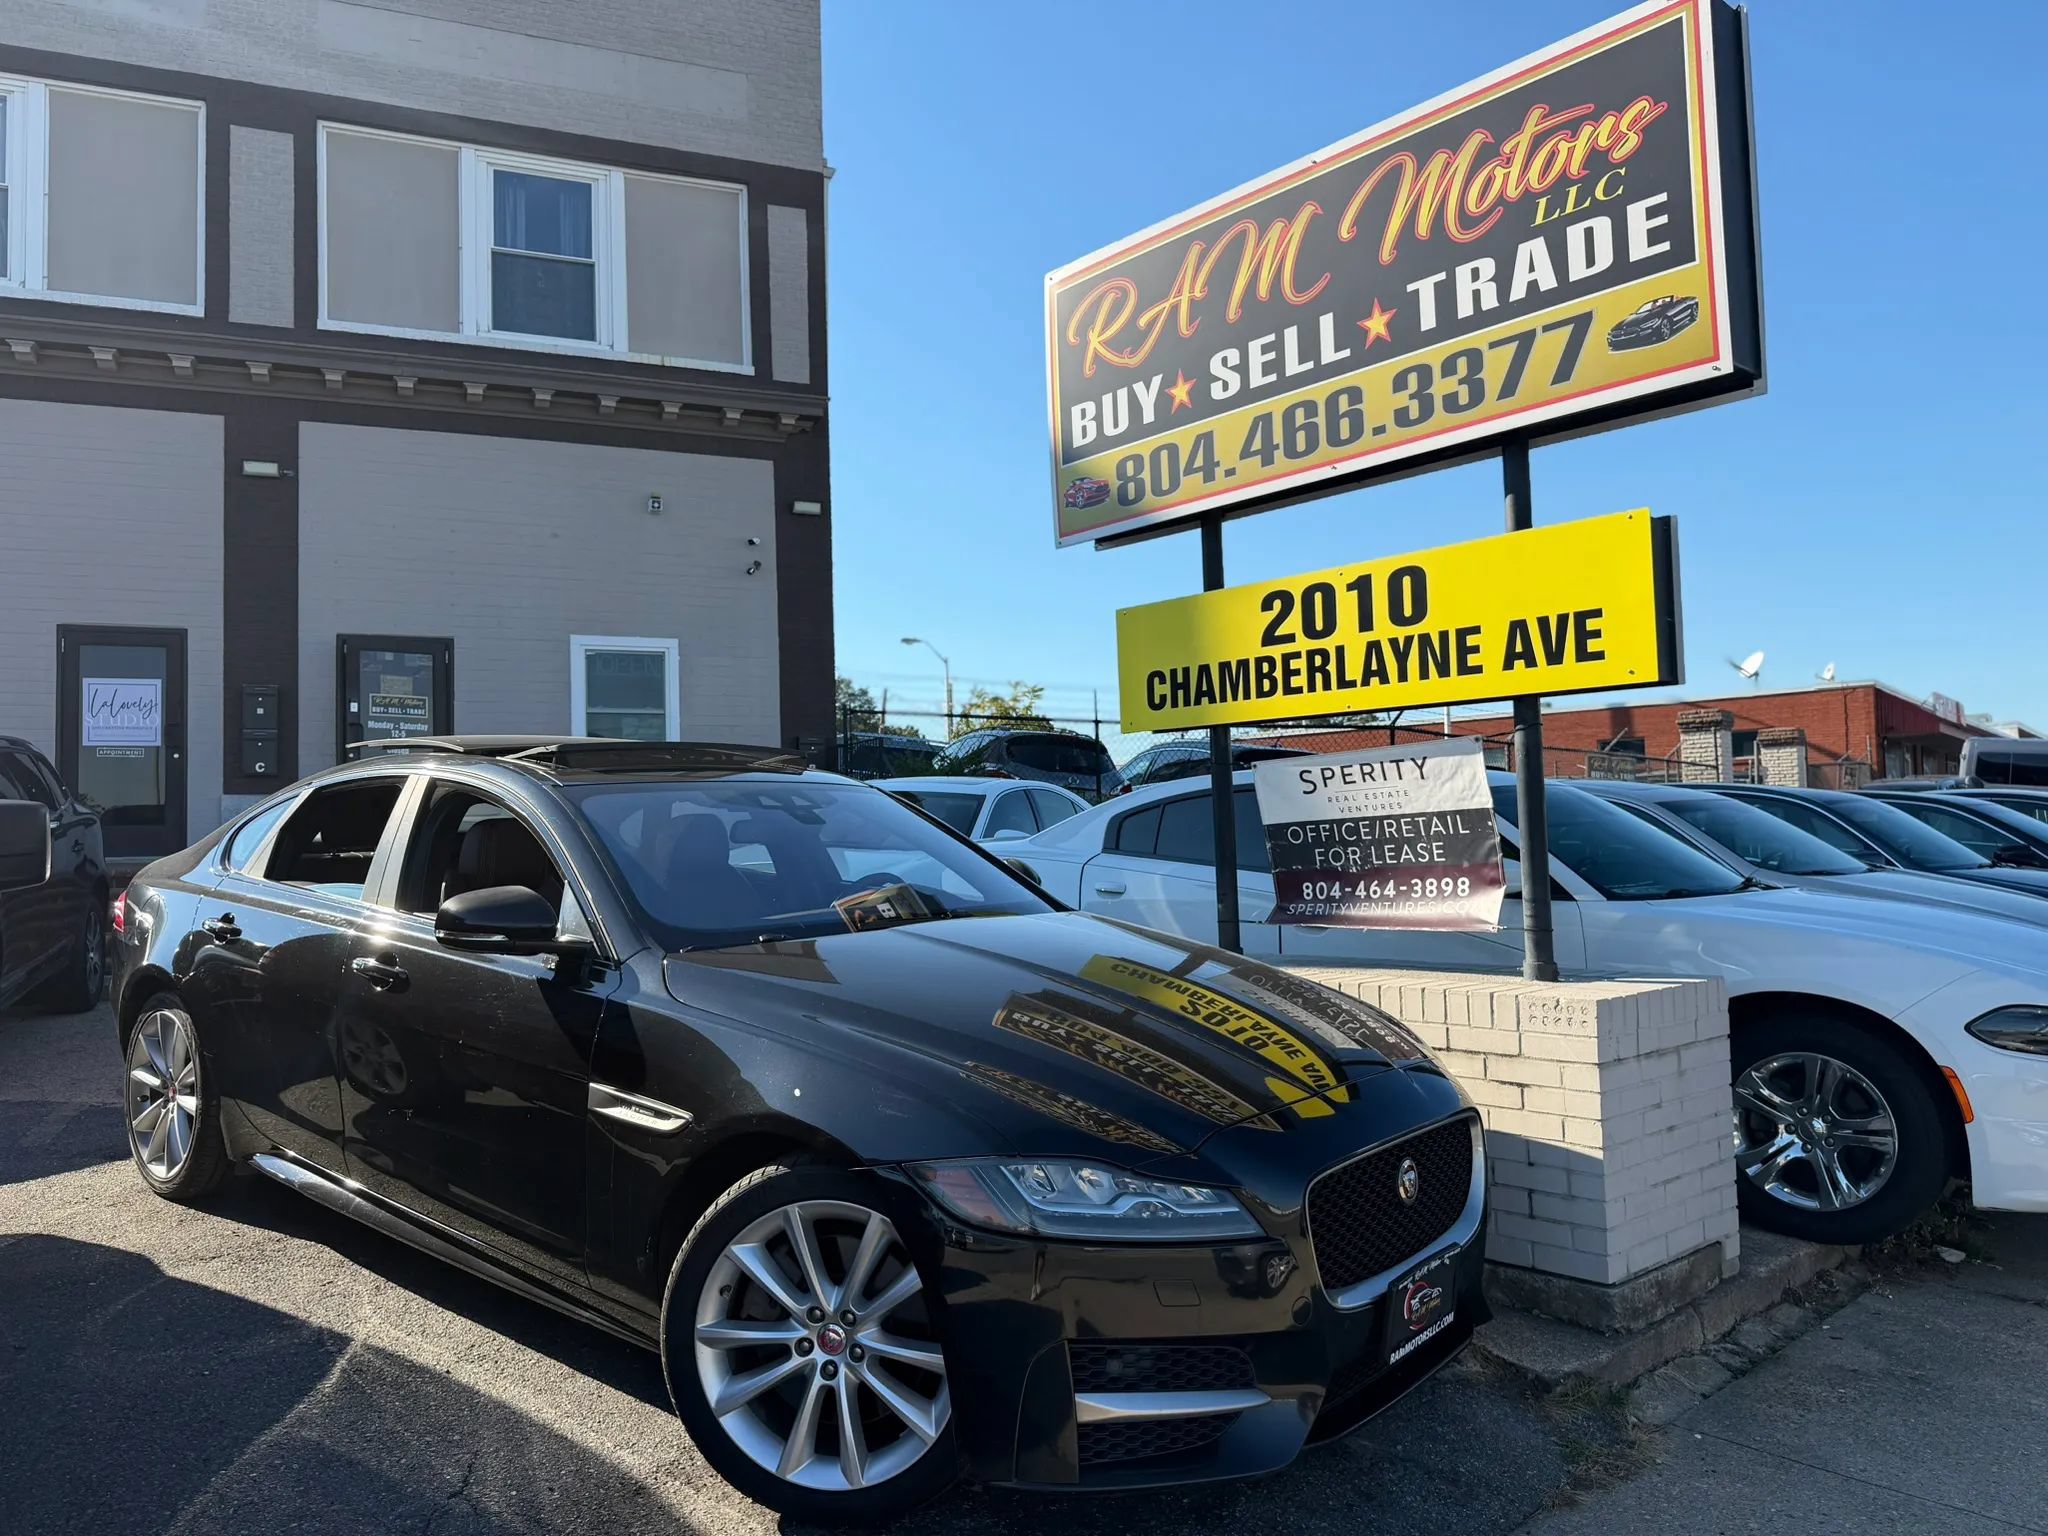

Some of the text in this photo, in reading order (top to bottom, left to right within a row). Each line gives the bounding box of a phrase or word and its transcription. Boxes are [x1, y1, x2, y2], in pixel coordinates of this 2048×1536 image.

[1531, 167, 1627, 228] LLC
[1066, 95, 1668, 378] RAM Motors
[1071, 192, 1672, 450] BUY SELL TRADE
[1115, 307, 1596, 508] 804.466.3377
[1260, 564, 1429, 648] 2010
[1146, 607, 1606, 711] CHAMBERLAYNE AVE
[368, 720, 394, 730] Monday
[400, 722, 429, 732] Saturday
[255, 762, 265, 773] C
[1299, 756, 1428, 795] SPERITY
[1327, 789, 1409, 803] REAL ESTATE
[1338, 803, 1403, 814] VENTURES
[1287, 814, 1470, 845] OFFICE/RETAIL
[1314, 842, 1446, 867] FOR LEASE
[1302, 877, 1471, 901] 804-464-3898
